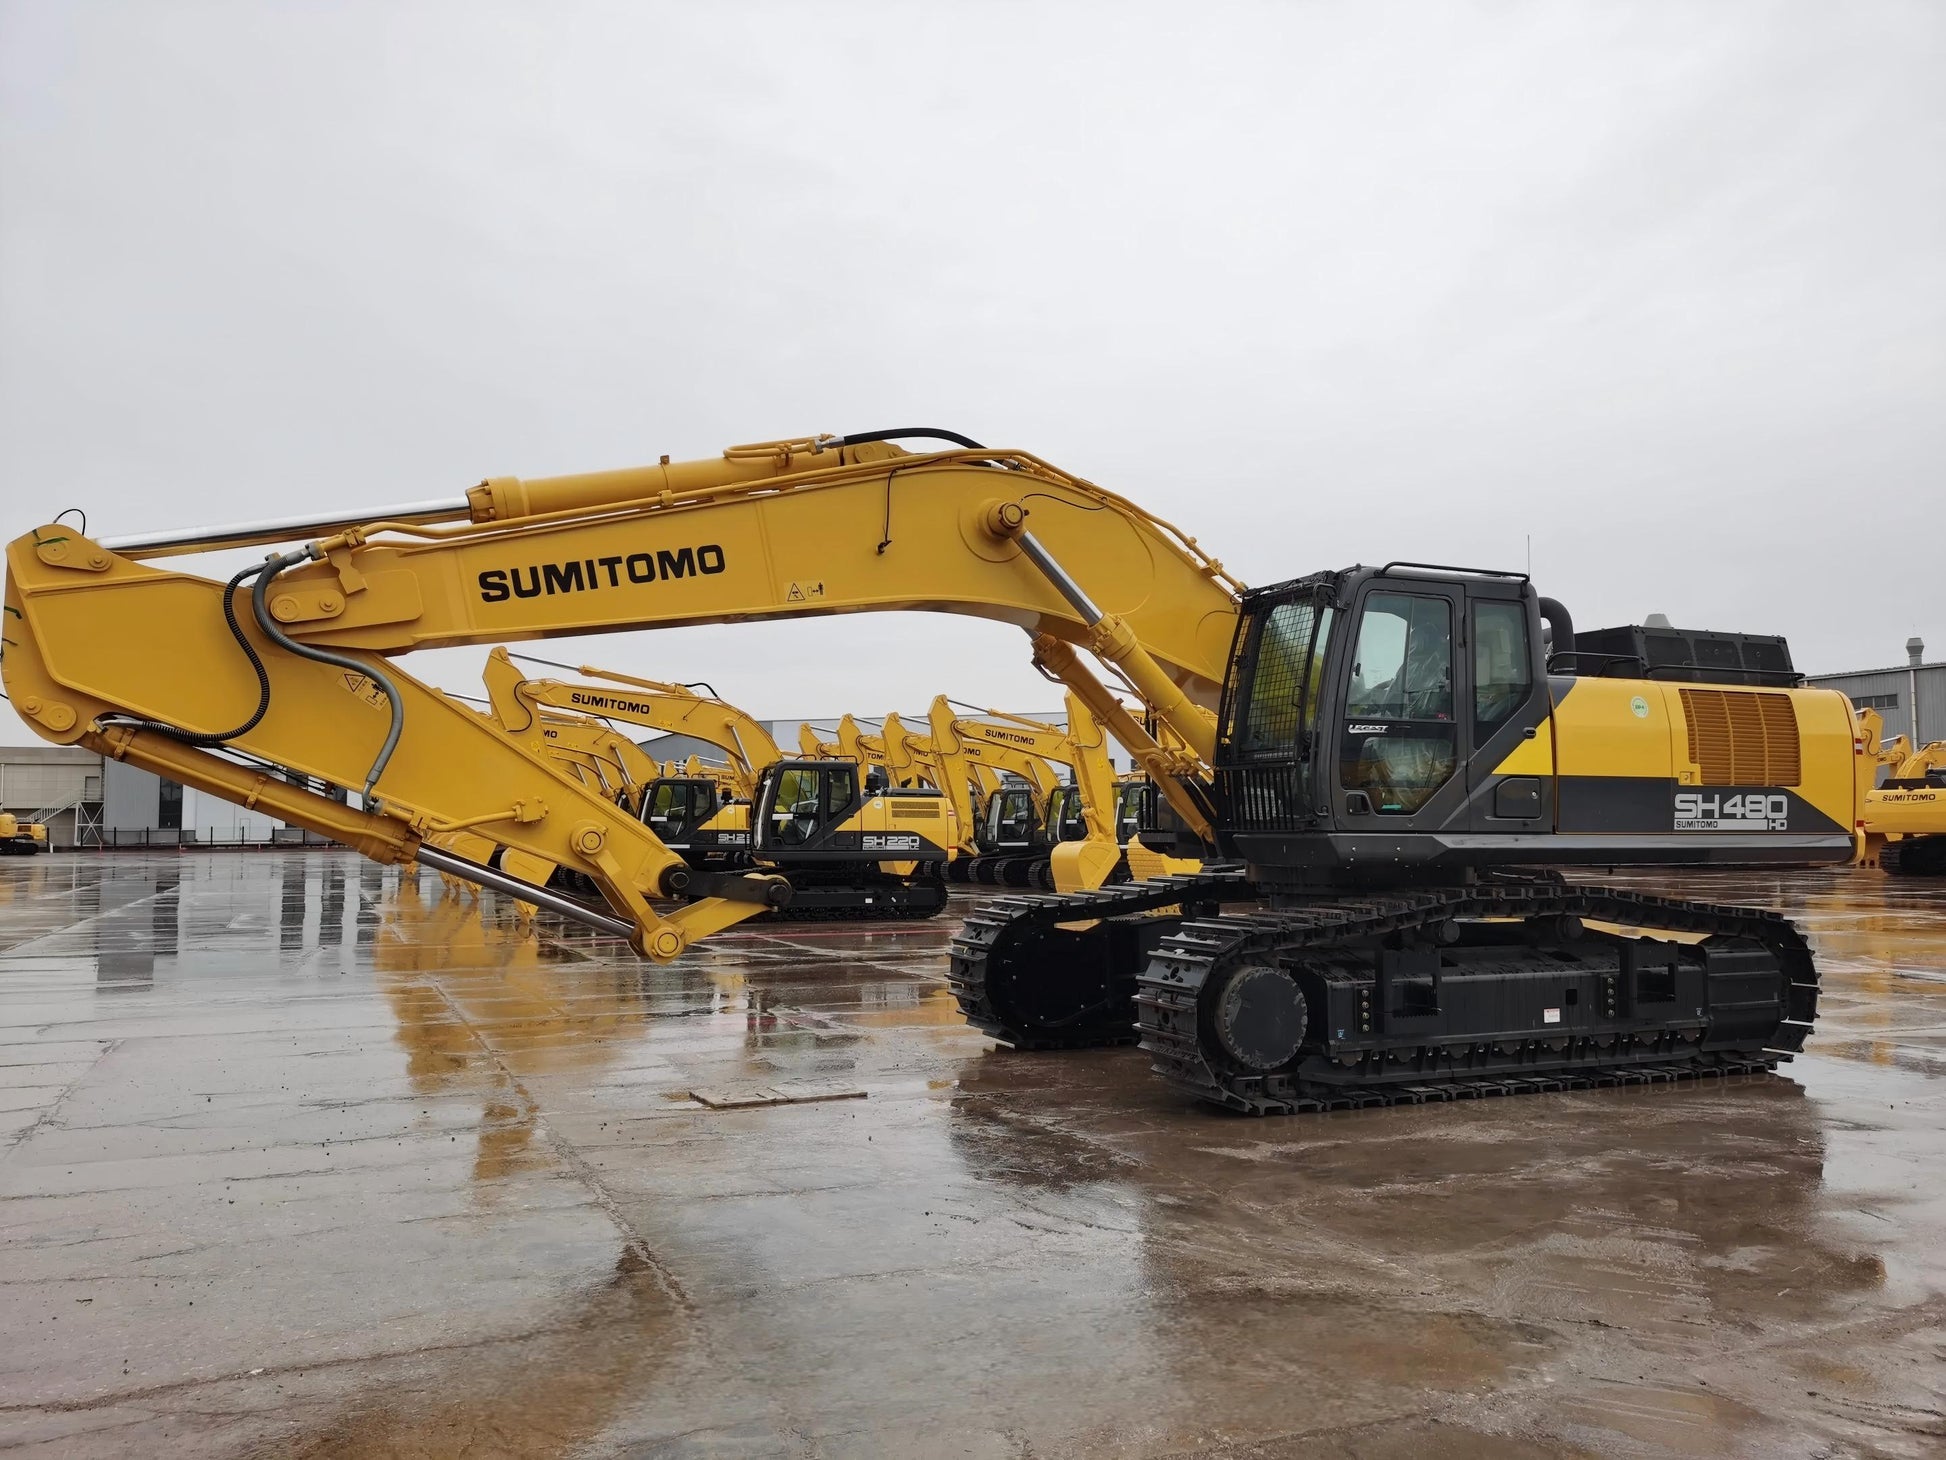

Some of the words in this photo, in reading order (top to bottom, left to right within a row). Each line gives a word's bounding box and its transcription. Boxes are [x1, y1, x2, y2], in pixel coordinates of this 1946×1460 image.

[478, 544, 726, 603] SUMITOMO
[571, 692, 650, 715] SUMITOMO
[1348, 724, 1388, 733] LEGEST
[985, 728, 1035, 746] SUMITOMO
[1882, 793, 1936, 802] SUMITOMO
[1675, 820, 1719, 829] SUMITOMO
[1768, 818, 1788, 831] HD
[717, 833, 750, 841] SH2
